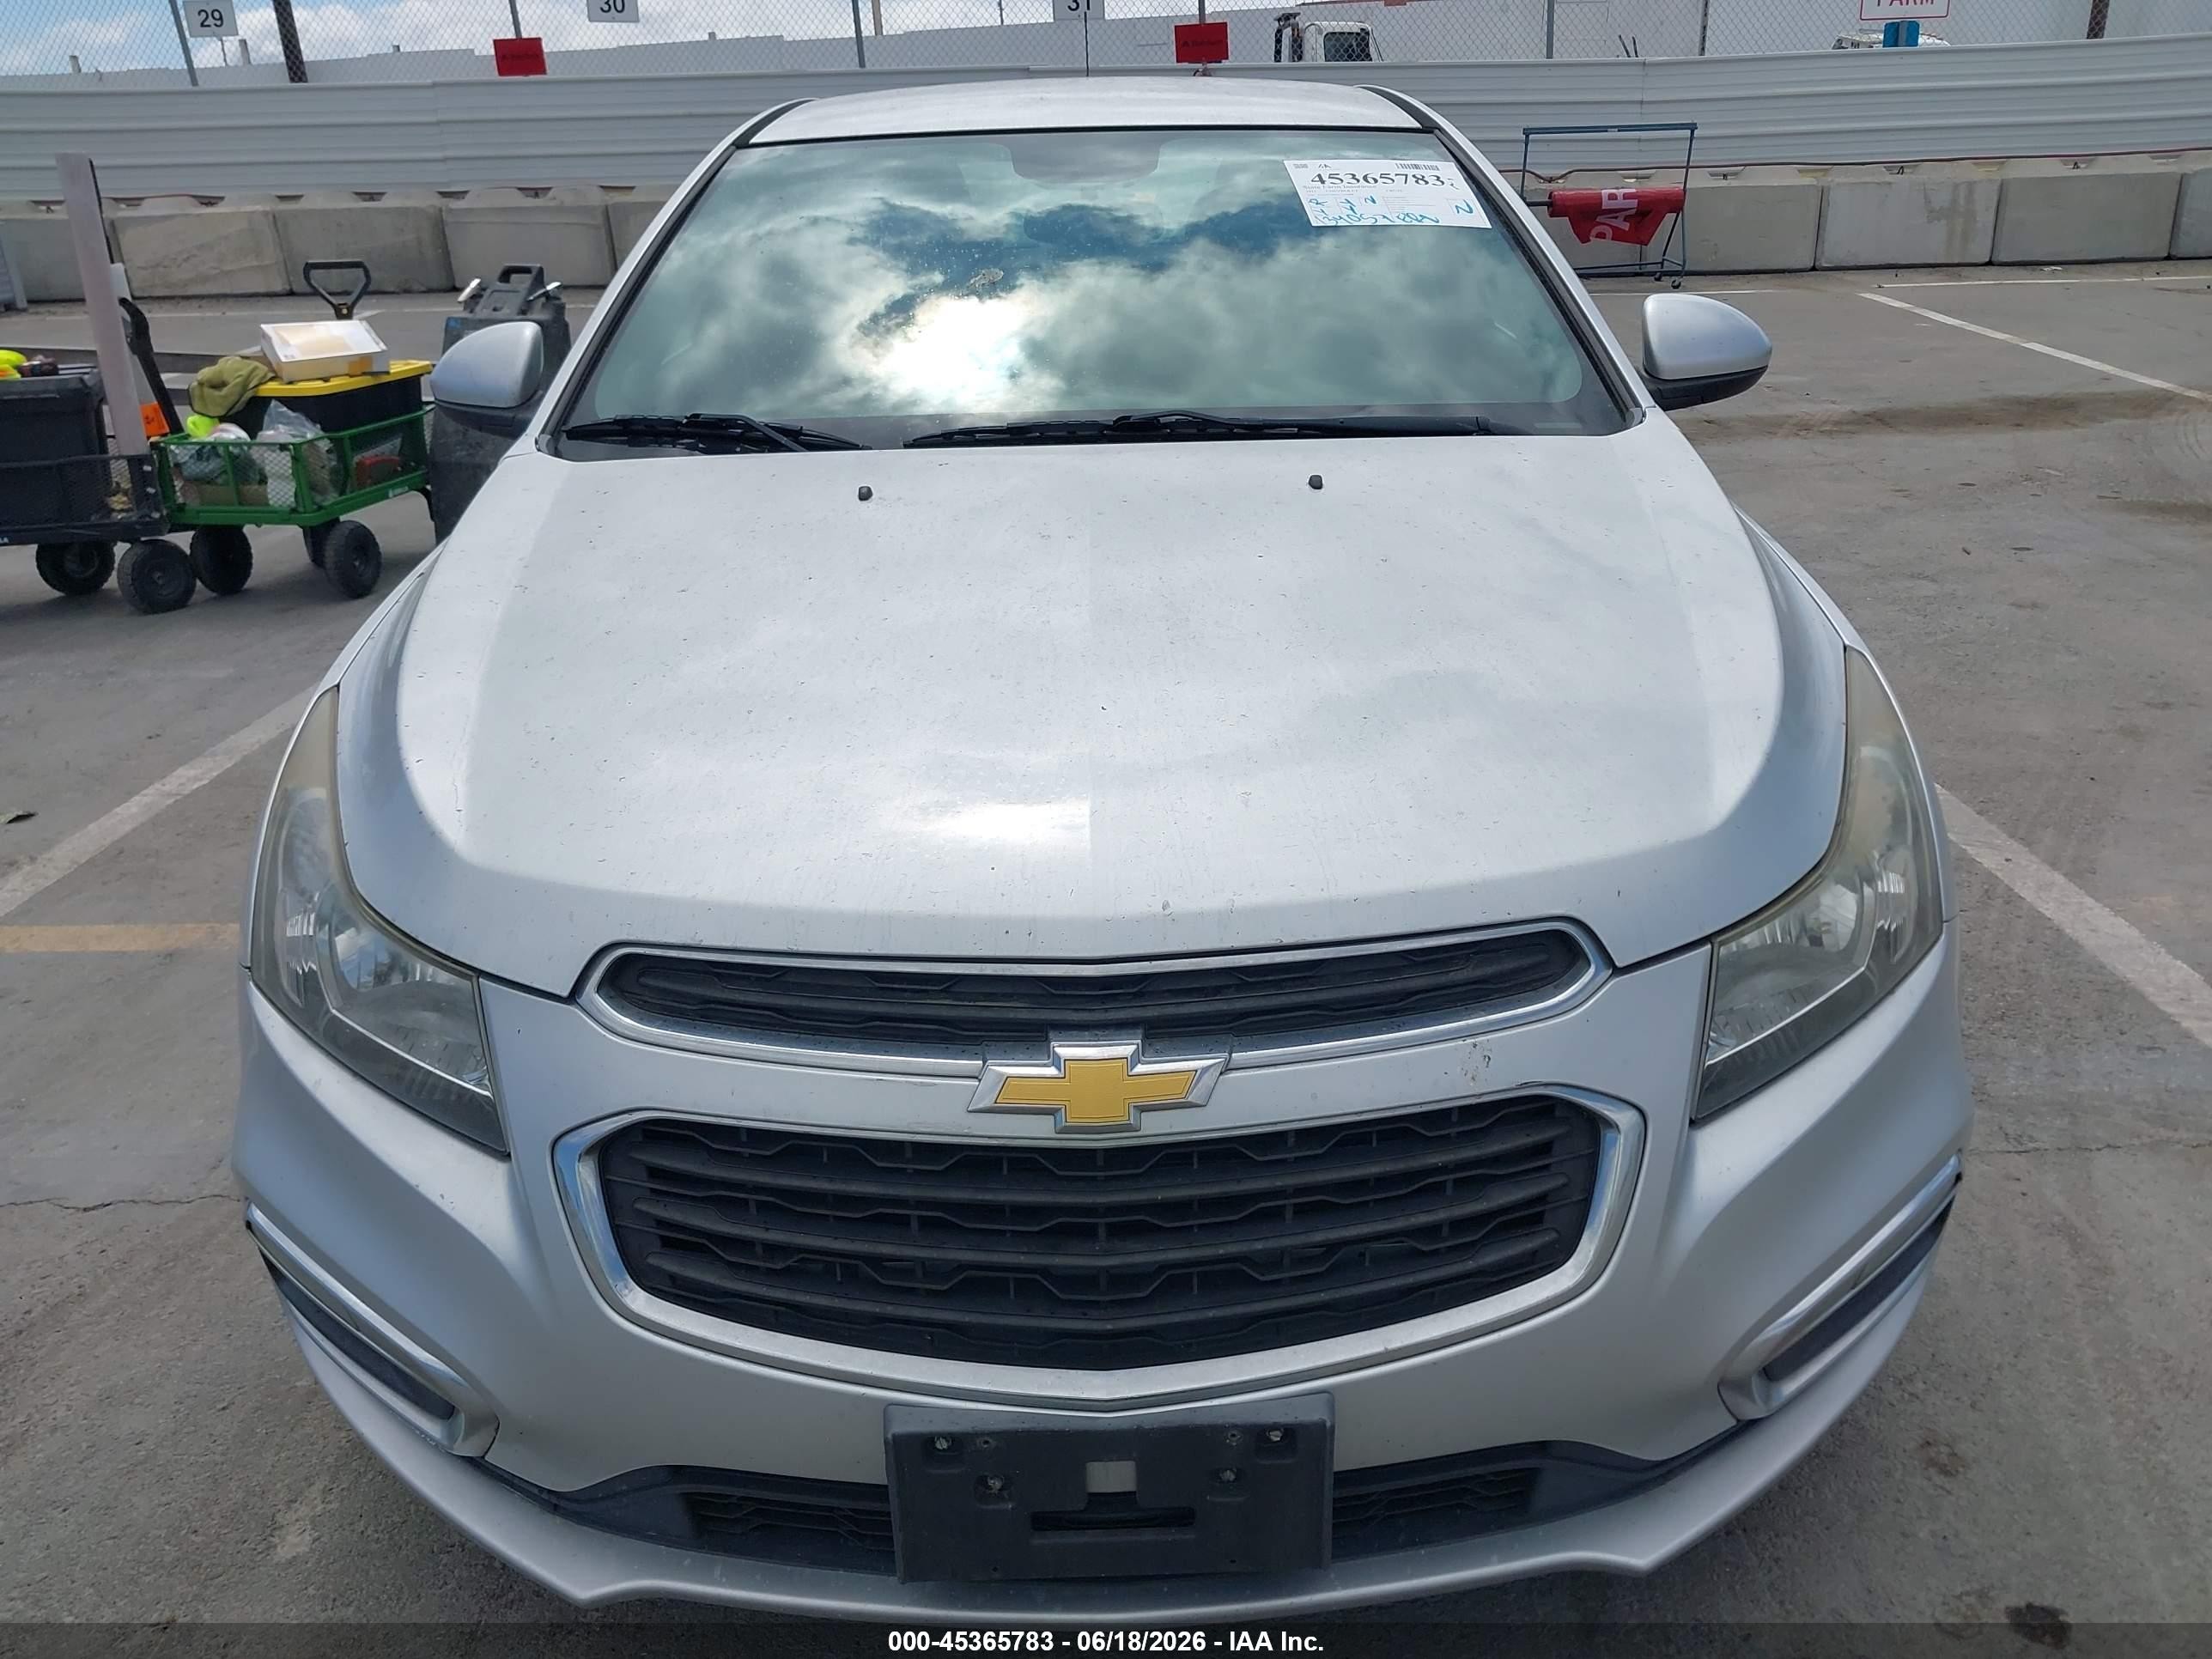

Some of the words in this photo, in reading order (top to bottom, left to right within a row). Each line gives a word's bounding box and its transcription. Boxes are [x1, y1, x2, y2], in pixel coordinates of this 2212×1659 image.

[600, 0, 625, 13] 30
[1067, 0, 1091, 11] 31
[198, 9, 224, 27] 29
[1311, 173, 1446, 186] 45365783
